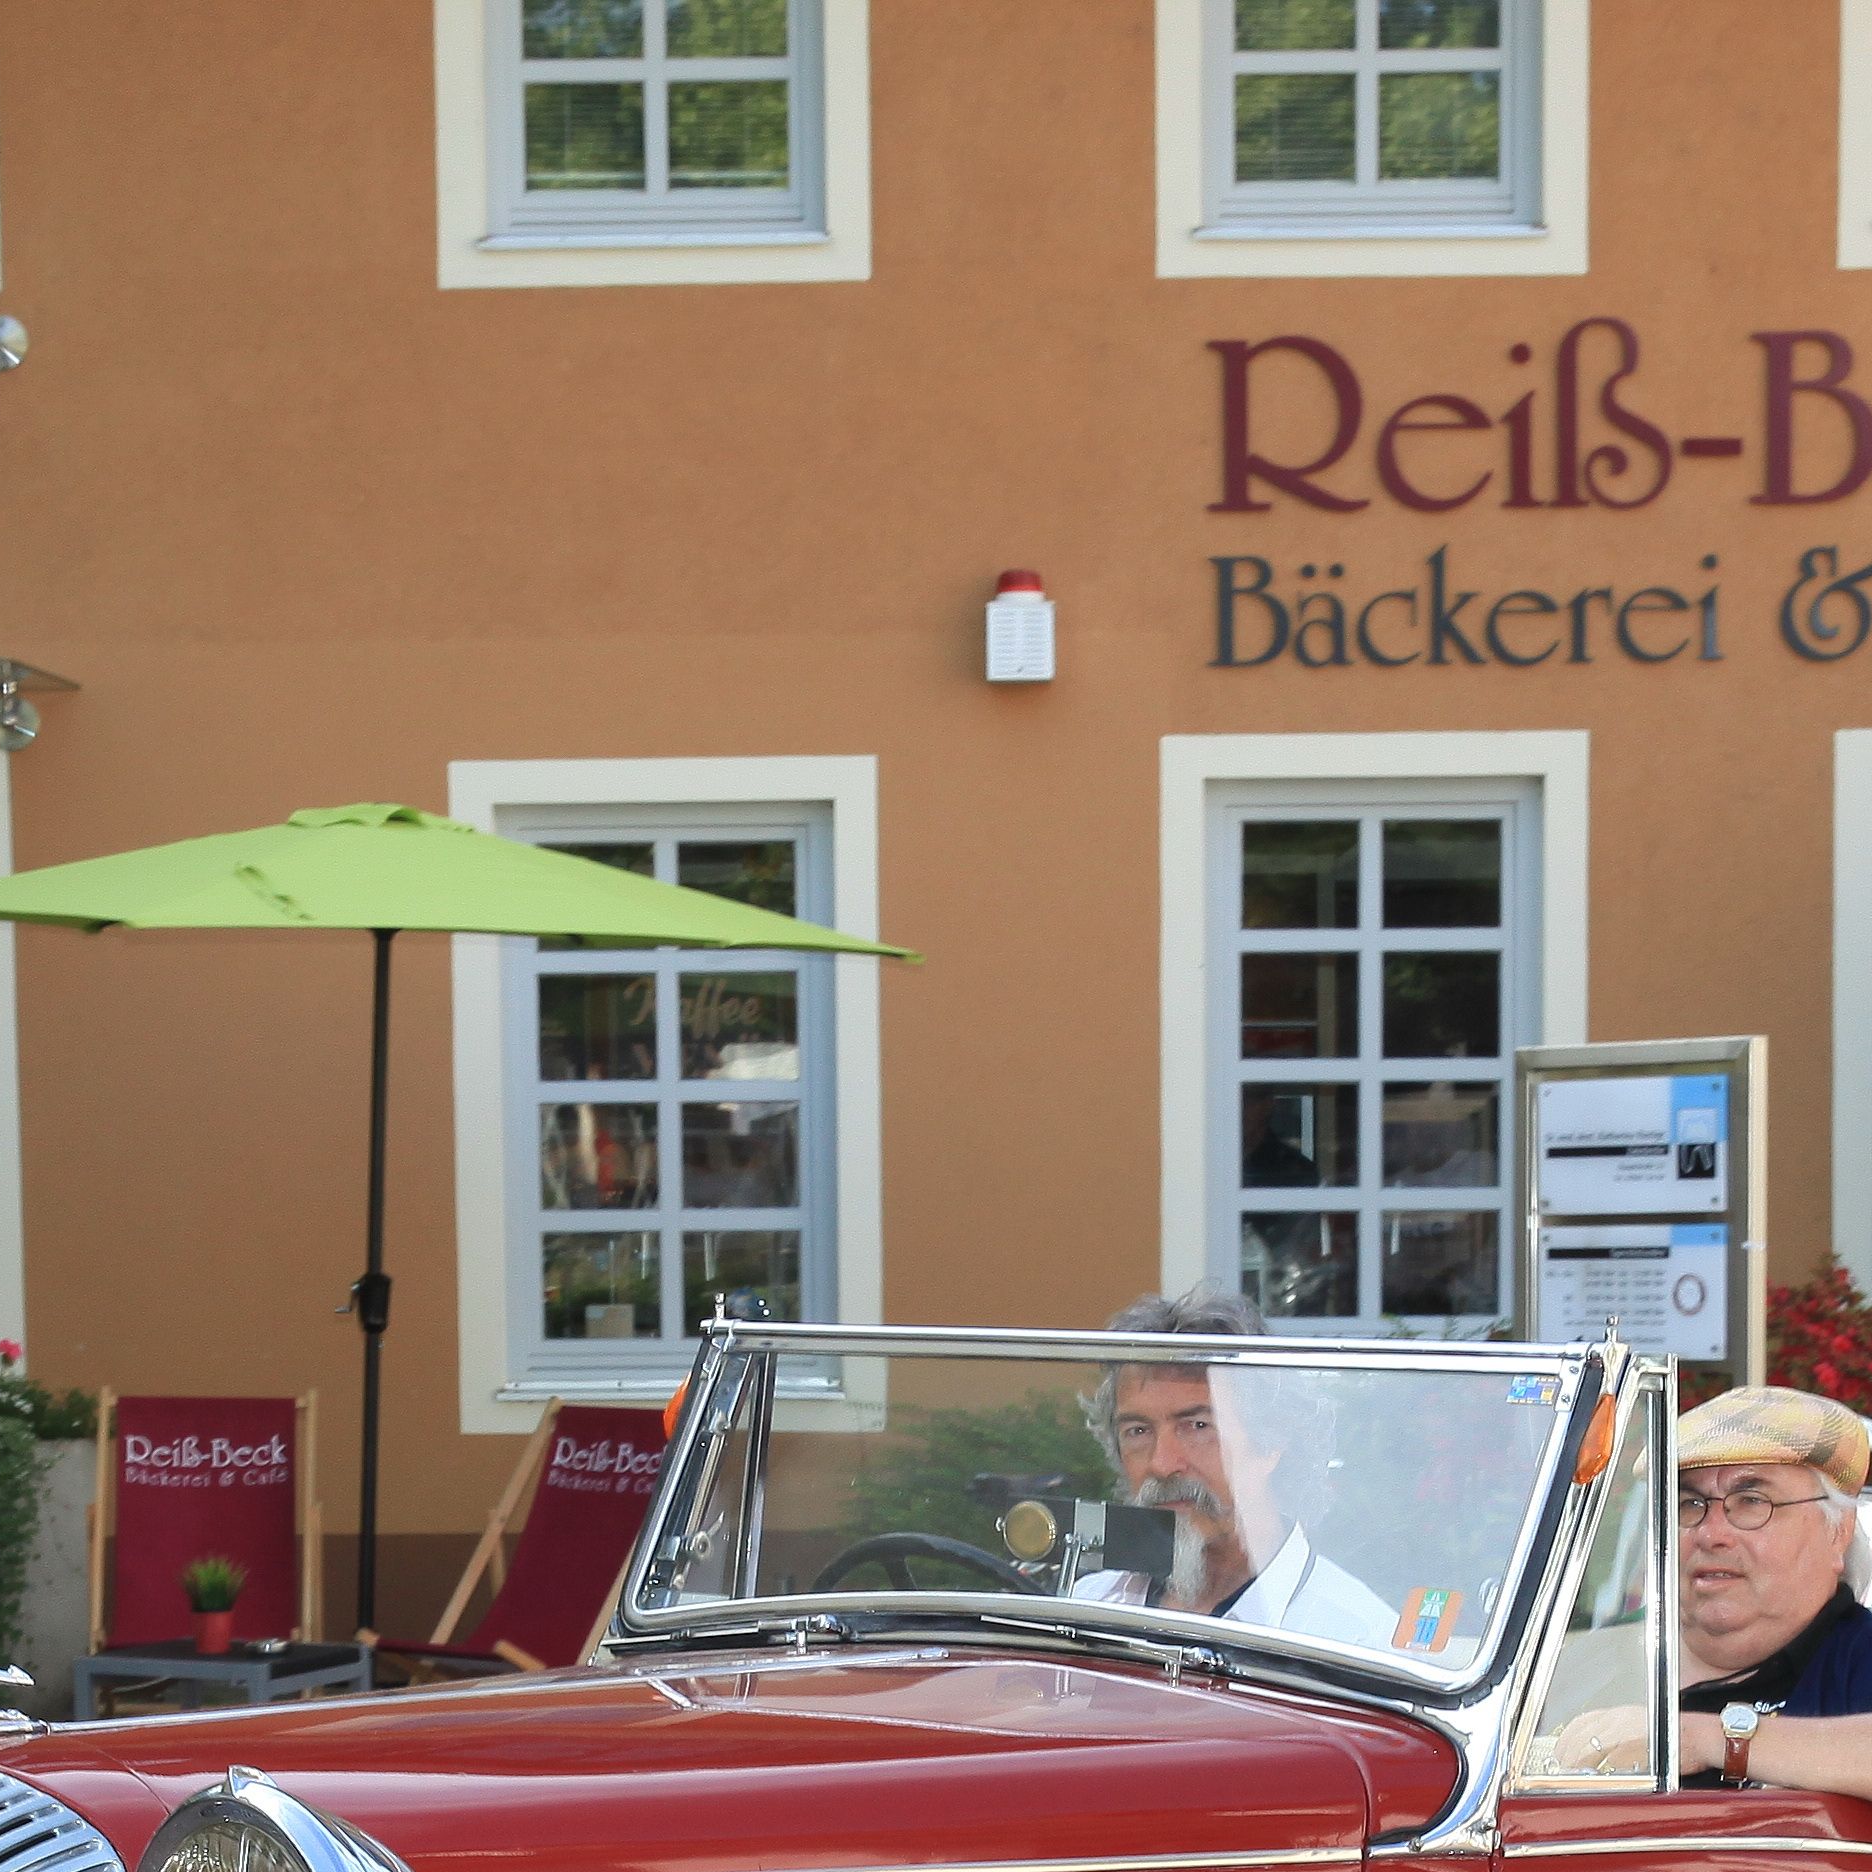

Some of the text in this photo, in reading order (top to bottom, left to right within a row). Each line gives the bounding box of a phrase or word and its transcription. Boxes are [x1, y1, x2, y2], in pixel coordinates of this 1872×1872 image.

[1206, 542, 1725, 669] Bäckerei
[124, 1434, 288, 1468] Reiß-Beck
[551, 1436, 668, 1474] Reiß-Bec
